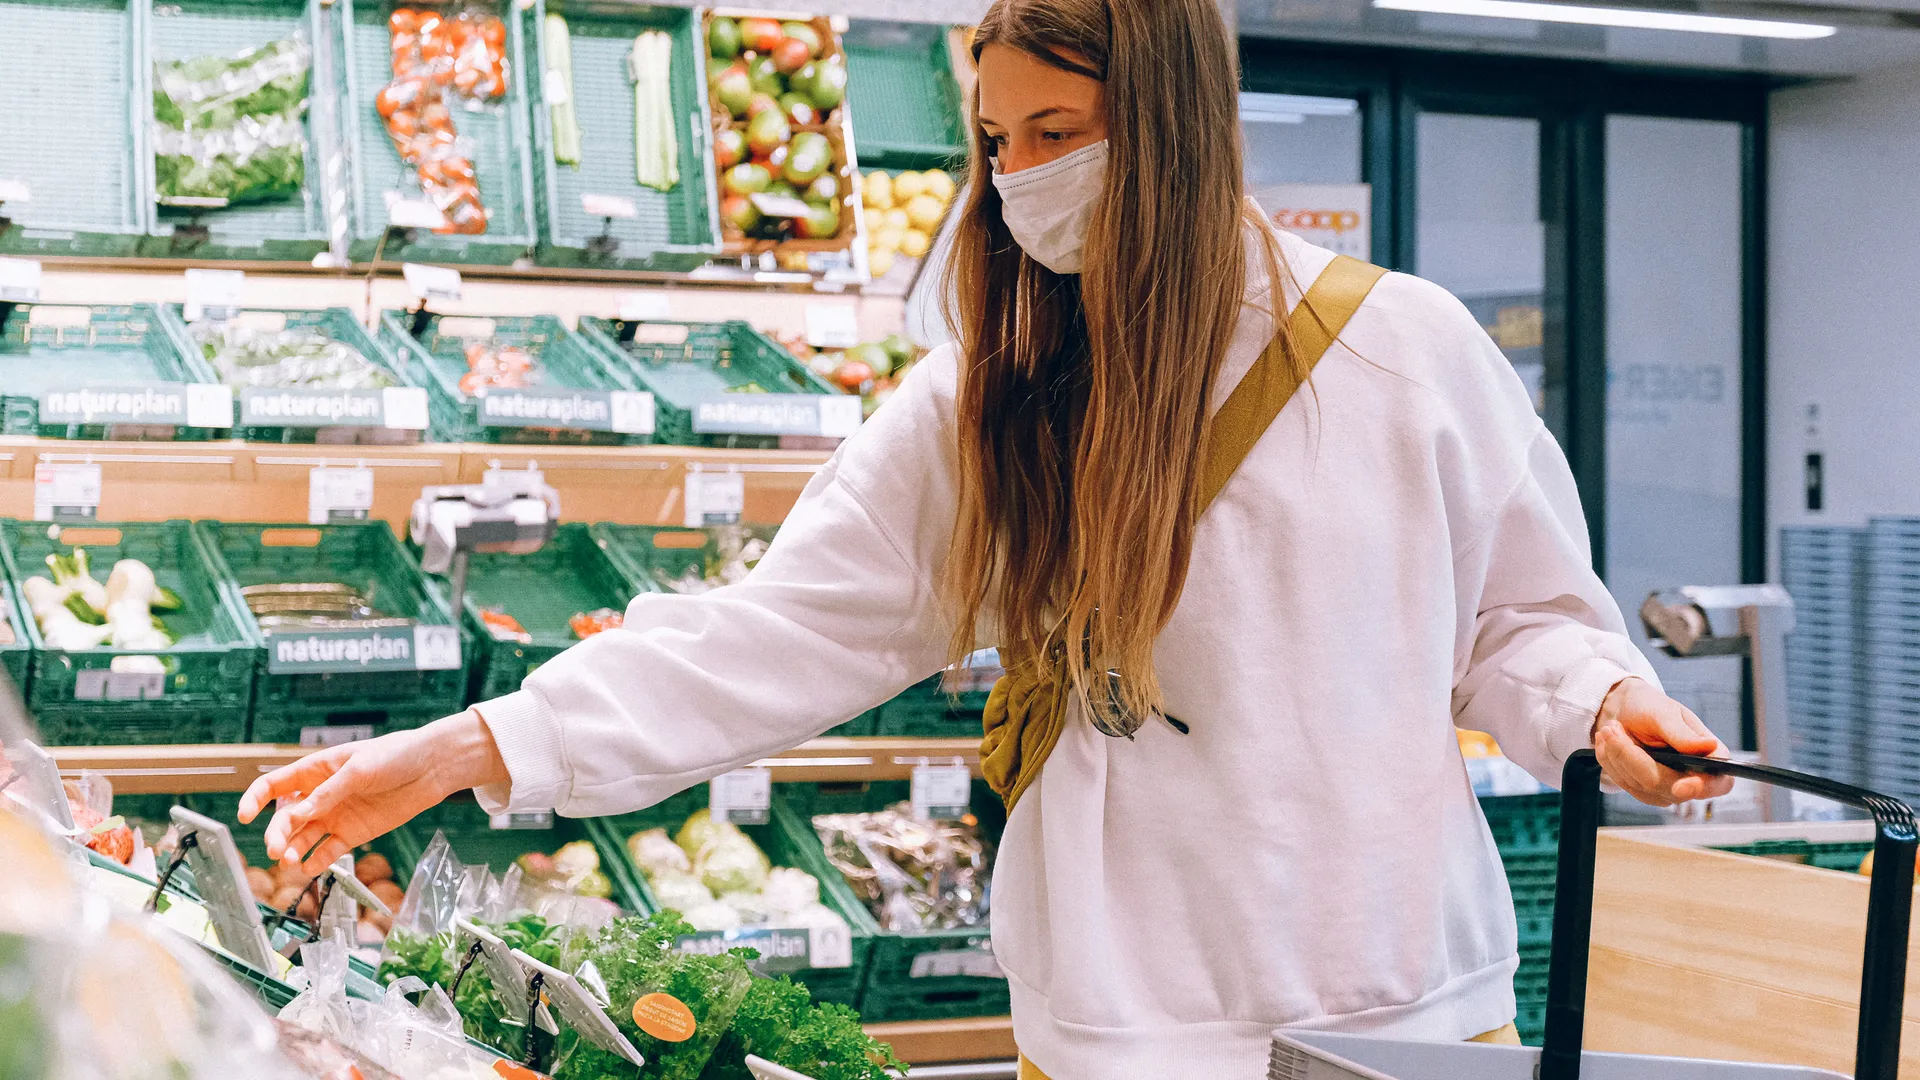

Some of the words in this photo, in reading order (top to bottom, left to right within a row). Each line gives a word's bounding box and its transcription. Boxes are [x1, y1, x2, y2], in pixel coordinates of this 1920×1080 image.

[1272, 208, 1360, 236] coop
[47, 388, 181, 419] naturaplan
[250, 389, 380, 420] naturaplan
[485, 392, 608, 425] naturaplan
[699, 400, 816, 427] naturaplan
[277, 632, 410, 666] naturaplan
